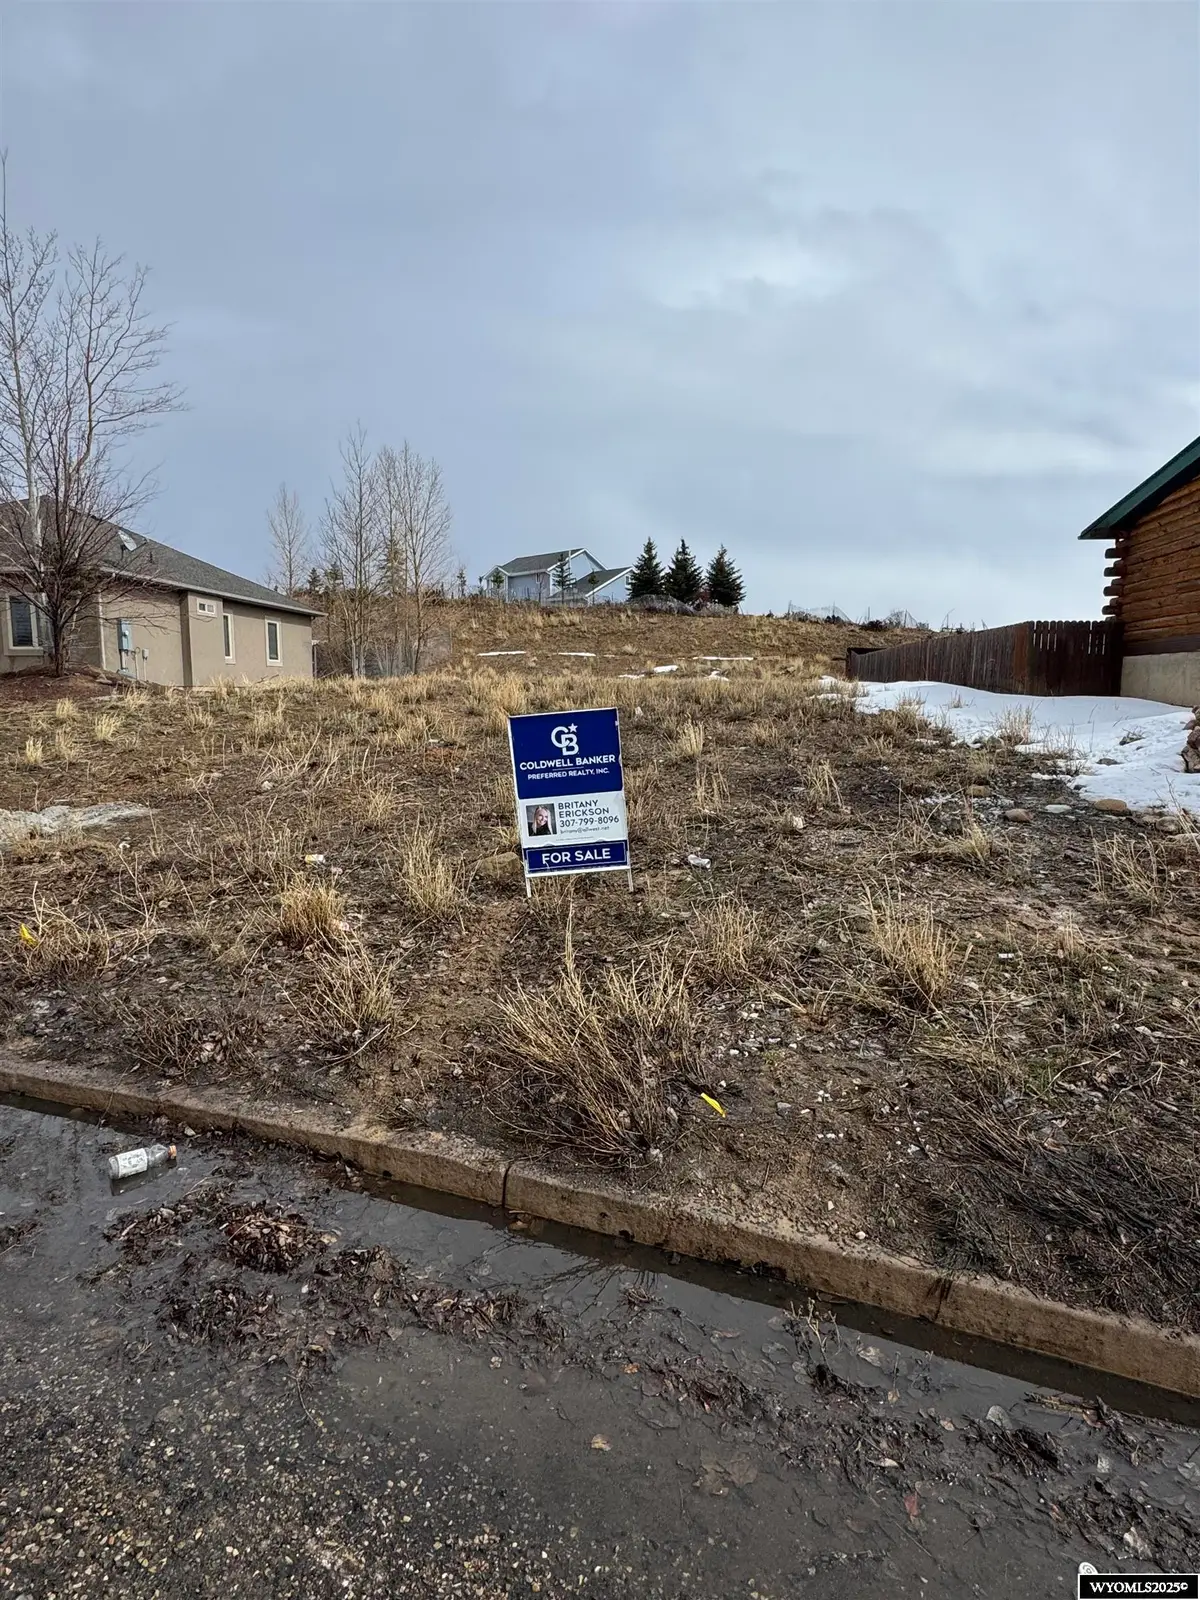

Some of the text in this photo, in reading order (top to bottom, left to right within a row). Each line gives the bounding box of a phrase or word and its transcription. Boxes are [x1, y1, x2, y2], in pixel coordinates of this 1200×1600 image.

[520, 754, 616, 770] COLDWELL BANKER
[528, 772, 568, 780] PREFERRED
[568, 769, 595, 777] REALTY,
[558, 800, 598, 810] BRITANY
[559, 808, 609, 818] ERICKSON
[559, 816, 619, 828] 307-799-8096
[542, 848, 611, 864] FOR SALE
